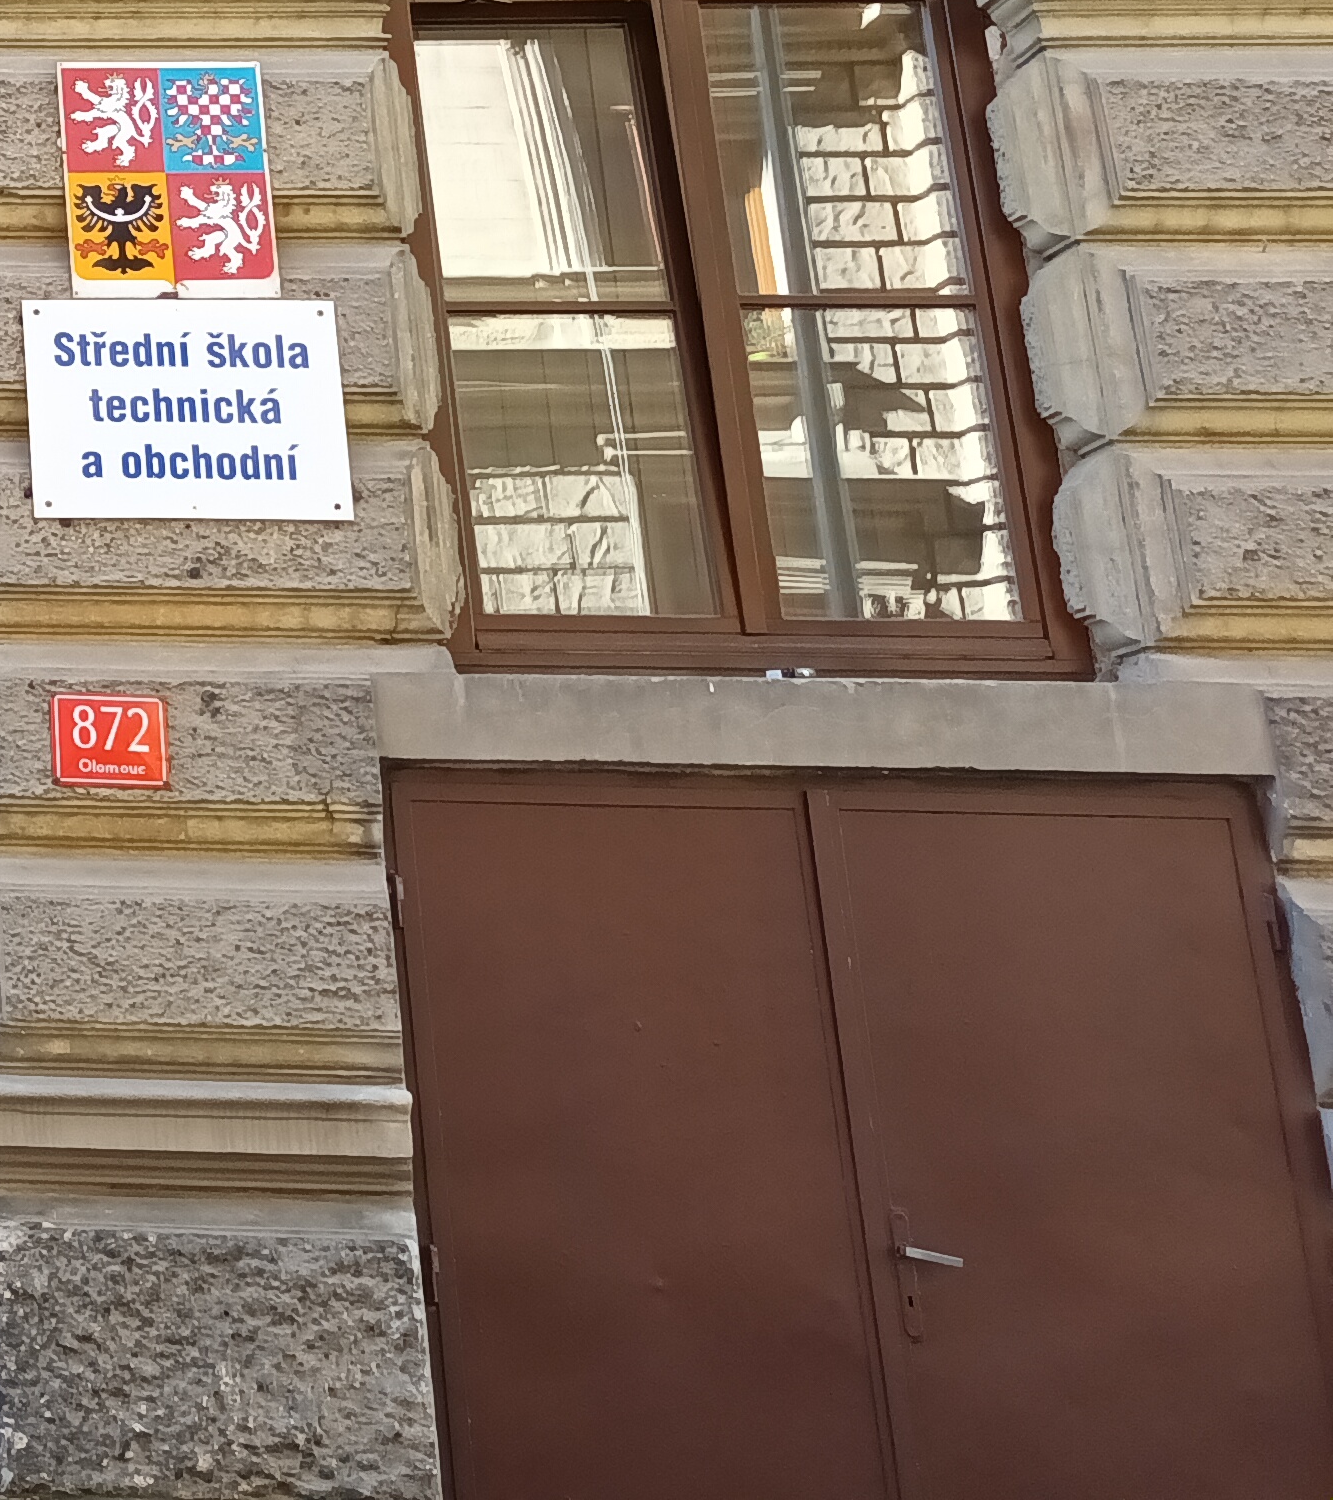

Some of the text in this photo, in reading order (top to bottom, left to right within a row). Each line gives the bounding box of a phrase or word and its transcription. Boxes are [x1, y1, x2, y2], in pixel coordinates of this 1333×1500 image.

[52, 330, 310, 369] Střední škola
[89, 387, 282, 425] technická
[81, 443, 300, 481] a obchodní
[72, 704, 150, 753] 872
[78, 758, 147, 775] Olomouc
